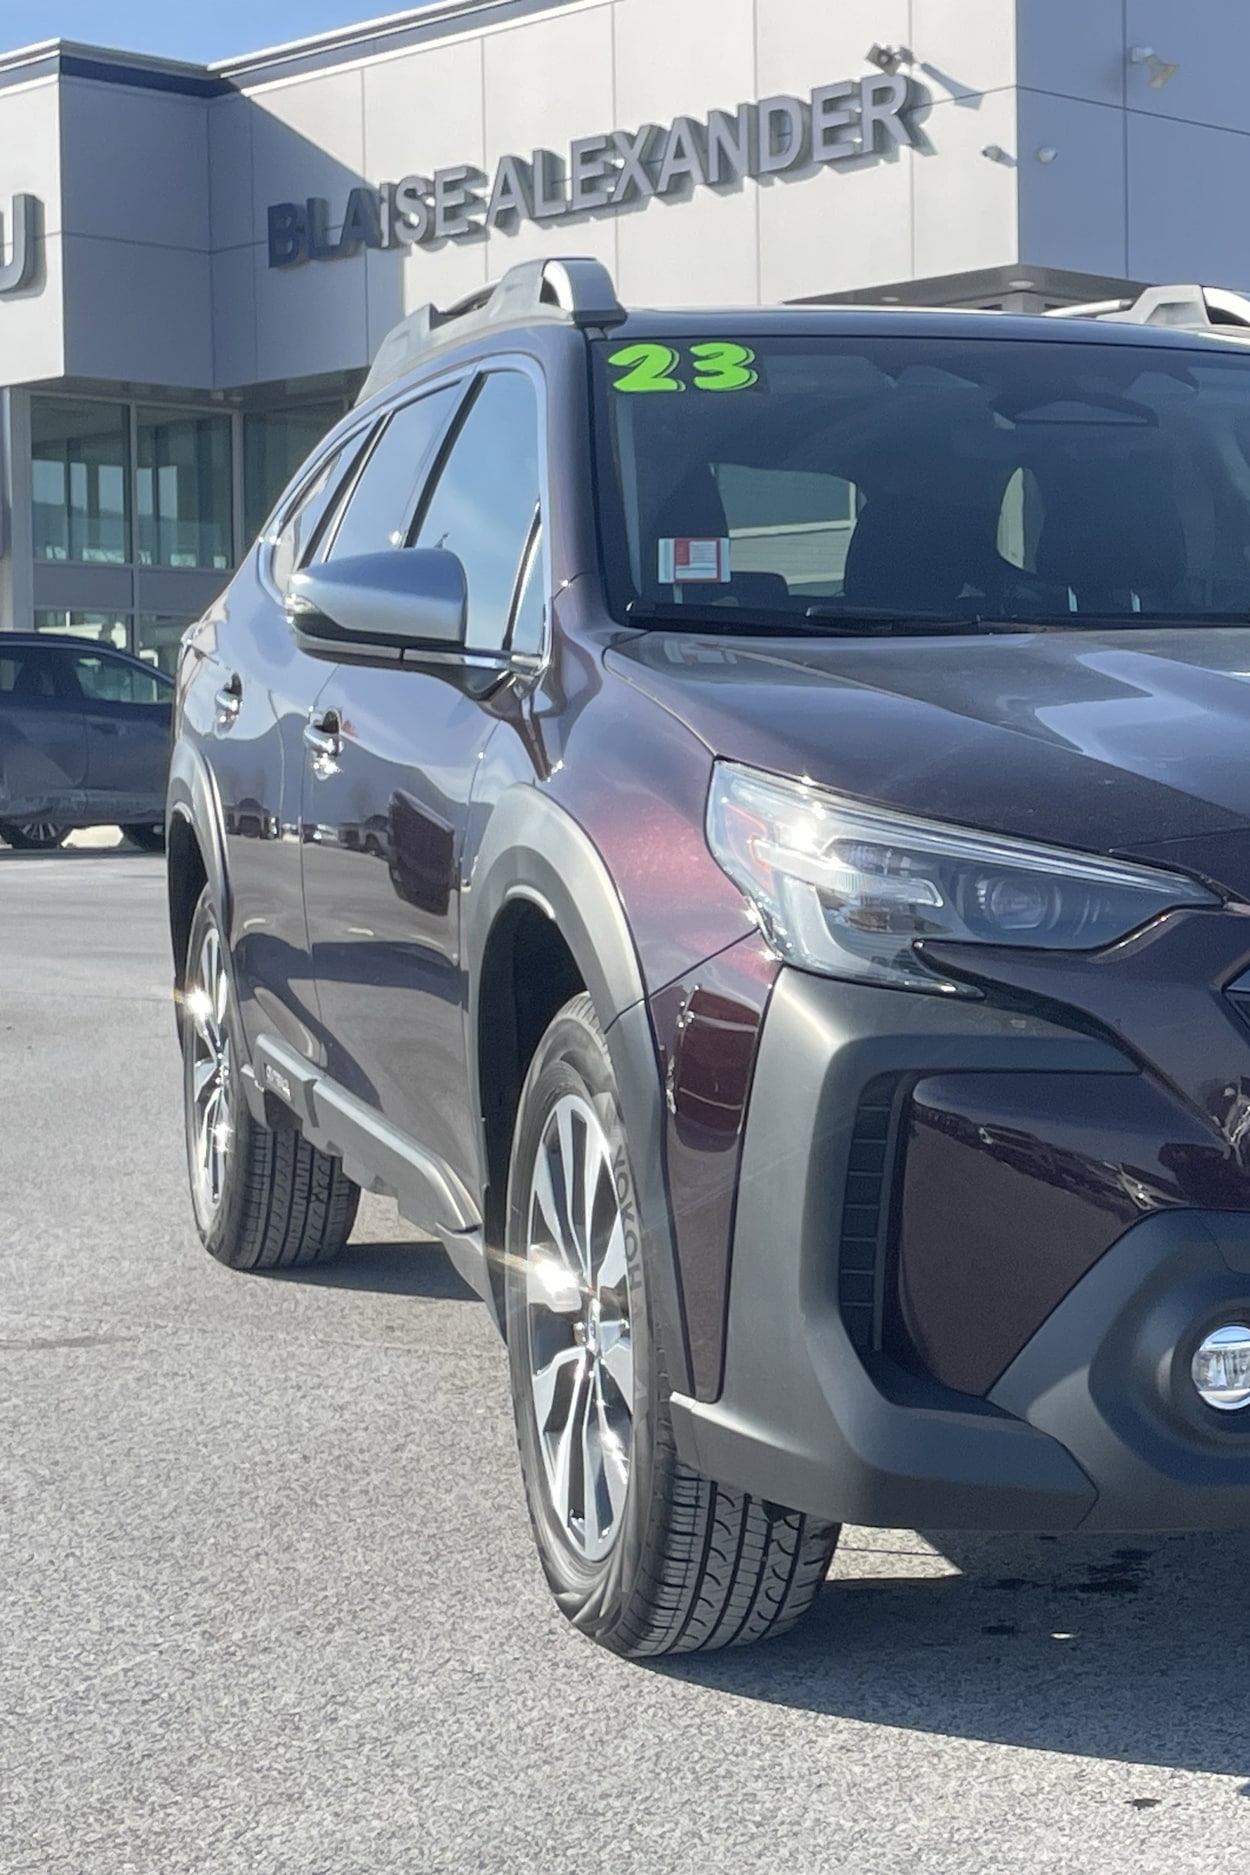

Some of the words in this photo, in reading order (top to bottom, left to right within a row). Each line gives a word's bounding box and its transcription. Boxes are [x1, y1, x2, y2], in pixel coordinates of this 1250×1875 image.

[267, 165, 474, 267] BLAISE
[485, 72, 912, 224] ALEXANDER
[608, 342, 758, 392] 23
